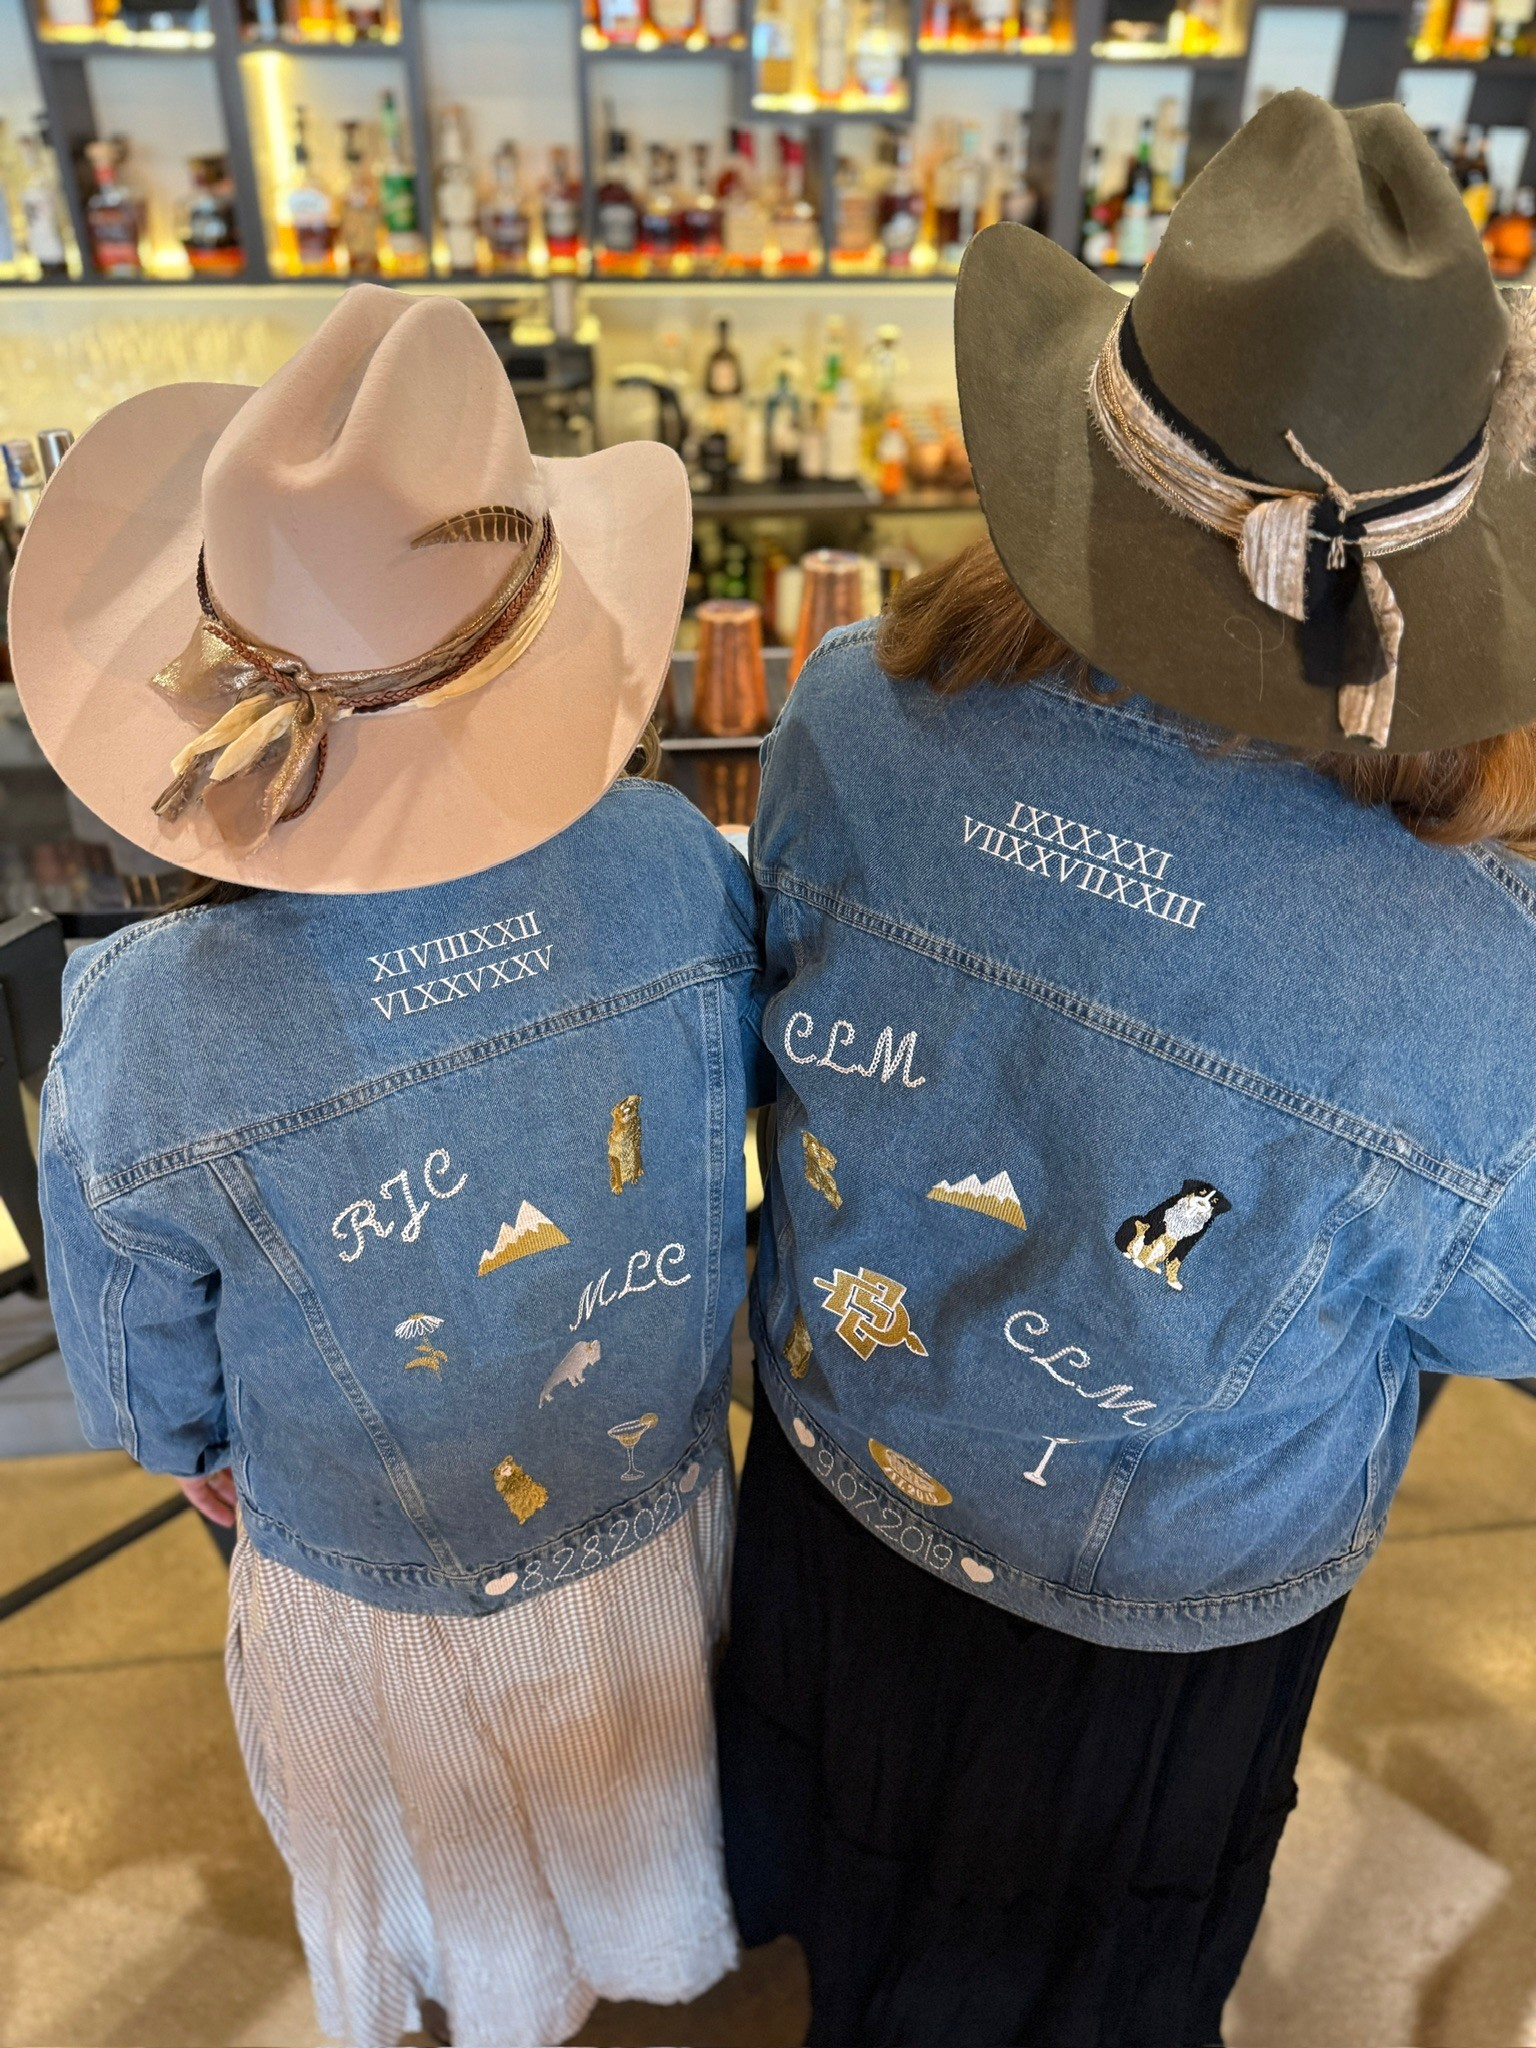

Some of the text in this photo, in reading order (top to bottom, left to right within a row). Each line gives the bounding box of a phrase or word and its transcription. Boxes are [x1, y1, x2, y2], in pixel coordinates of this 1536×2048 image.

[964, 815, 1206, 929] VIIXXVIIXXIII
[368, 910, 542, 982] XIVIIIXXII
[371, 944, 553, 1020] VIXXVXXV
[784, 1010, 926, 1088] CLM
[332, 1148, 468, 1262] RJC
[569, 1242, 691, 1332] MLC
[1003, 1310, 1157, 1427] CLM
[521, 1481, 682, 1591] 8.28.2021
[816, 1449, 953, 1570] 9.07.2019
